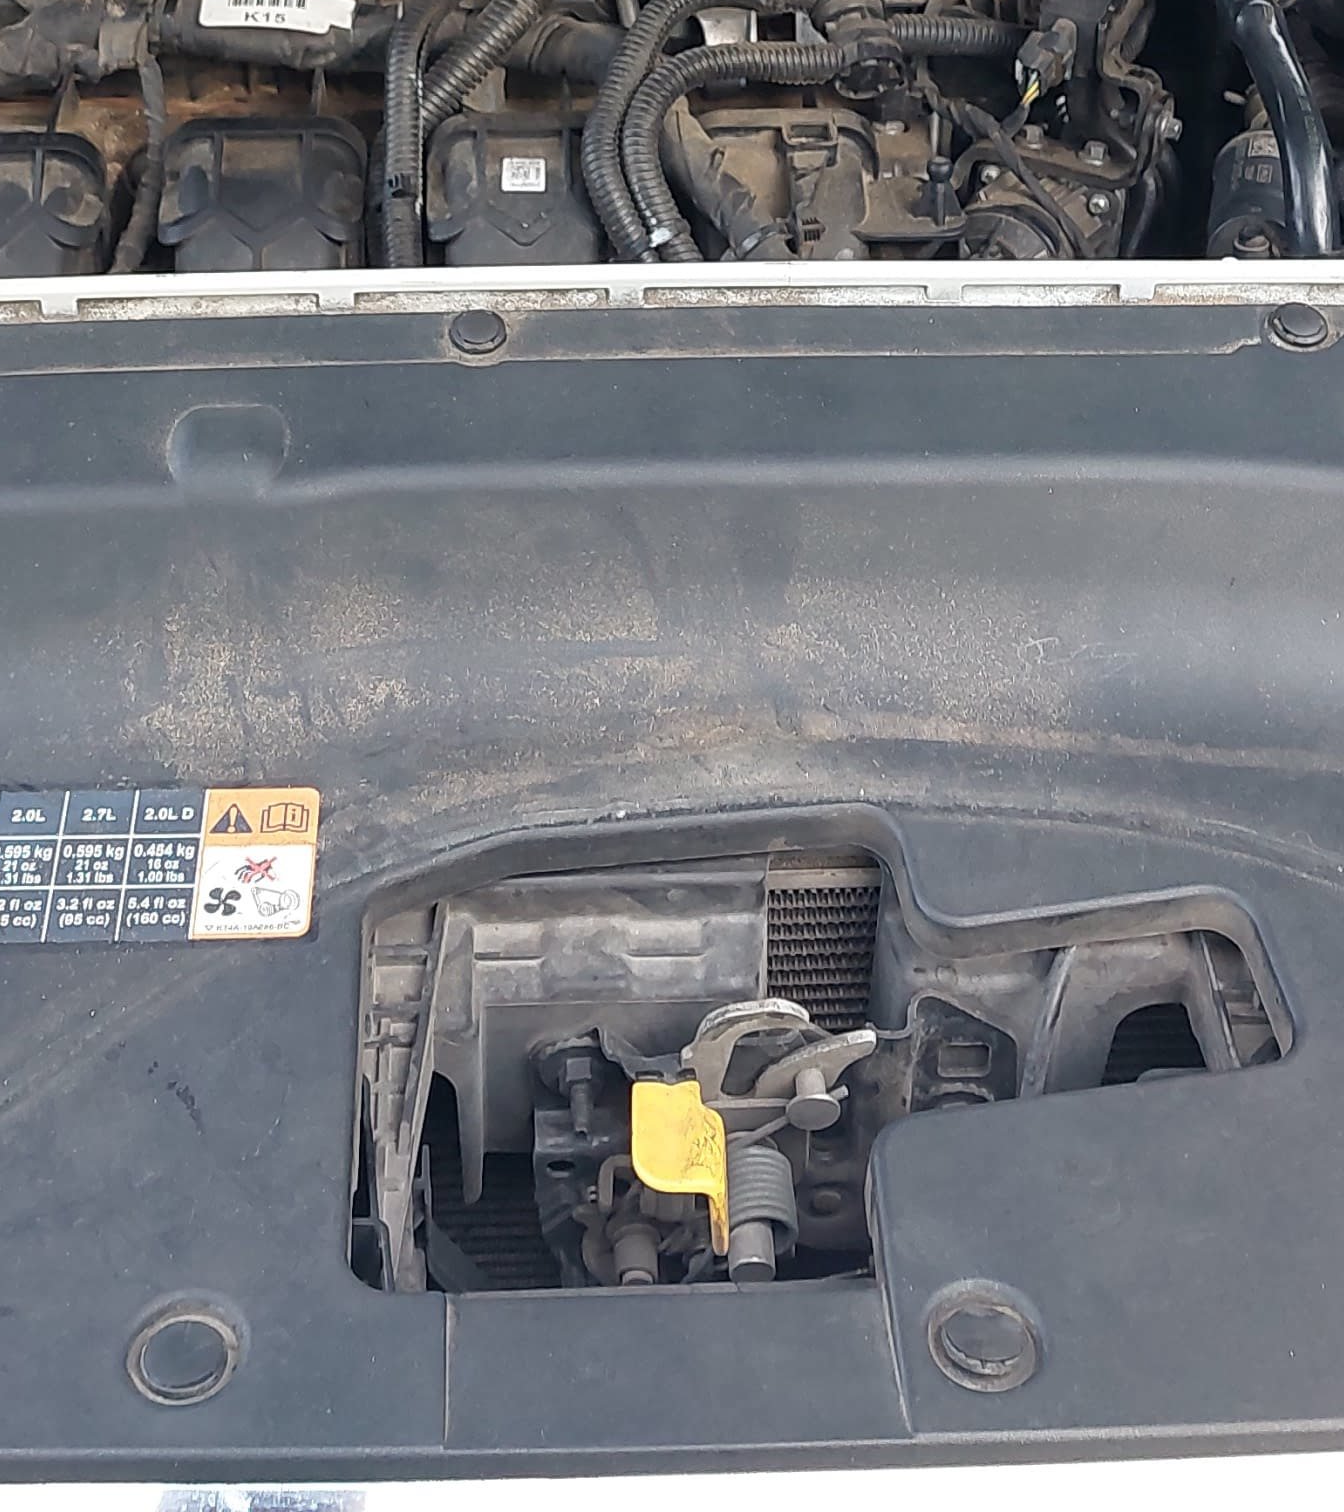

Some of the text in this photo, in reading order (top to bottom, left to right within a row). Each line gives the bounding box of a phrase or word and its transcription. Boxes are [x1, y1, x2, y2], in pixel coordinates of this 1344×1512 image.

[244, 11, 286, 23] K15
[11, 808, 46, 823] 2.0L
[81, 807, 117, 822] 2.7L
[144, 807, 195, 821] 2.0L D
[33, 844, 53, 861] kg
[63, 844, 125, 861] 0.595 kg
[176, 843, 195, 861] kg
[2, 860, 37, 871] 21 oz
[74, 860, 109, 871] 21 oz
[147, 859, 180, 870] 16 oz
[21, 873, 42, 884] lbs
[66, 873, 114, 884] 1.31 lbs
[137, 872, 185, 883] 1.00 lbs
[9, 898, 20, 911] fl
[23, 900, 42, 911] oz
[56, 898, 115, 911] 3.2 fl oz
[127, 897, 186, 910] 5.4 fl oz
[12, 915, 37, 928] cc)
[86, 914, 110, 928] cc)
[126, 912, 186, 927] (160 cc)
